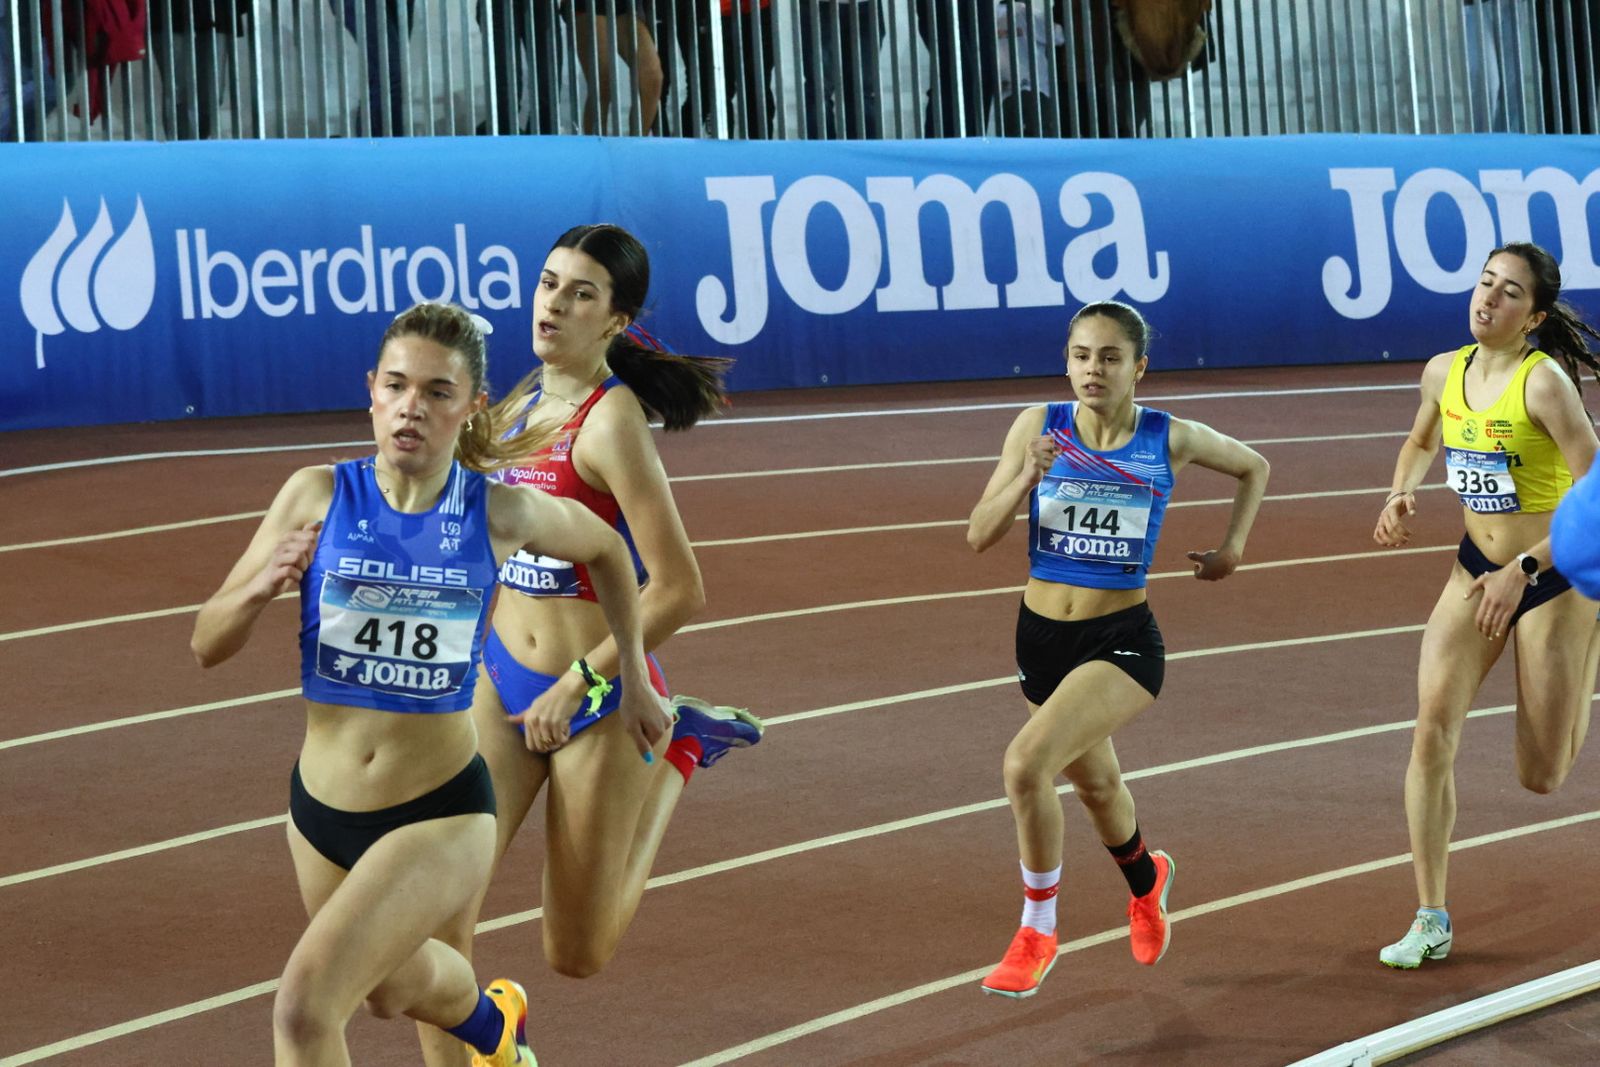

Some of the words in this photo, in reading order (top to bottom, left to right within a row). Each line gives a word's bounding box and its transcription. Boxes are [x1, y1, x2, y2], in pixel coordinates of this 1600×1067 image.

[175, 223, 521, 320] Iberdrola
[695, 171, 1170, 346] Joma
[1457, 470, 1499, 494] 336
[1063, 505, 1120, 536] 144
[1064, 534, 1131, 557] Joma
[338, 556, 468, 586] SOLISS
[354, 617, 439, 661] 418
[357, 659, 451, 690] Joma
